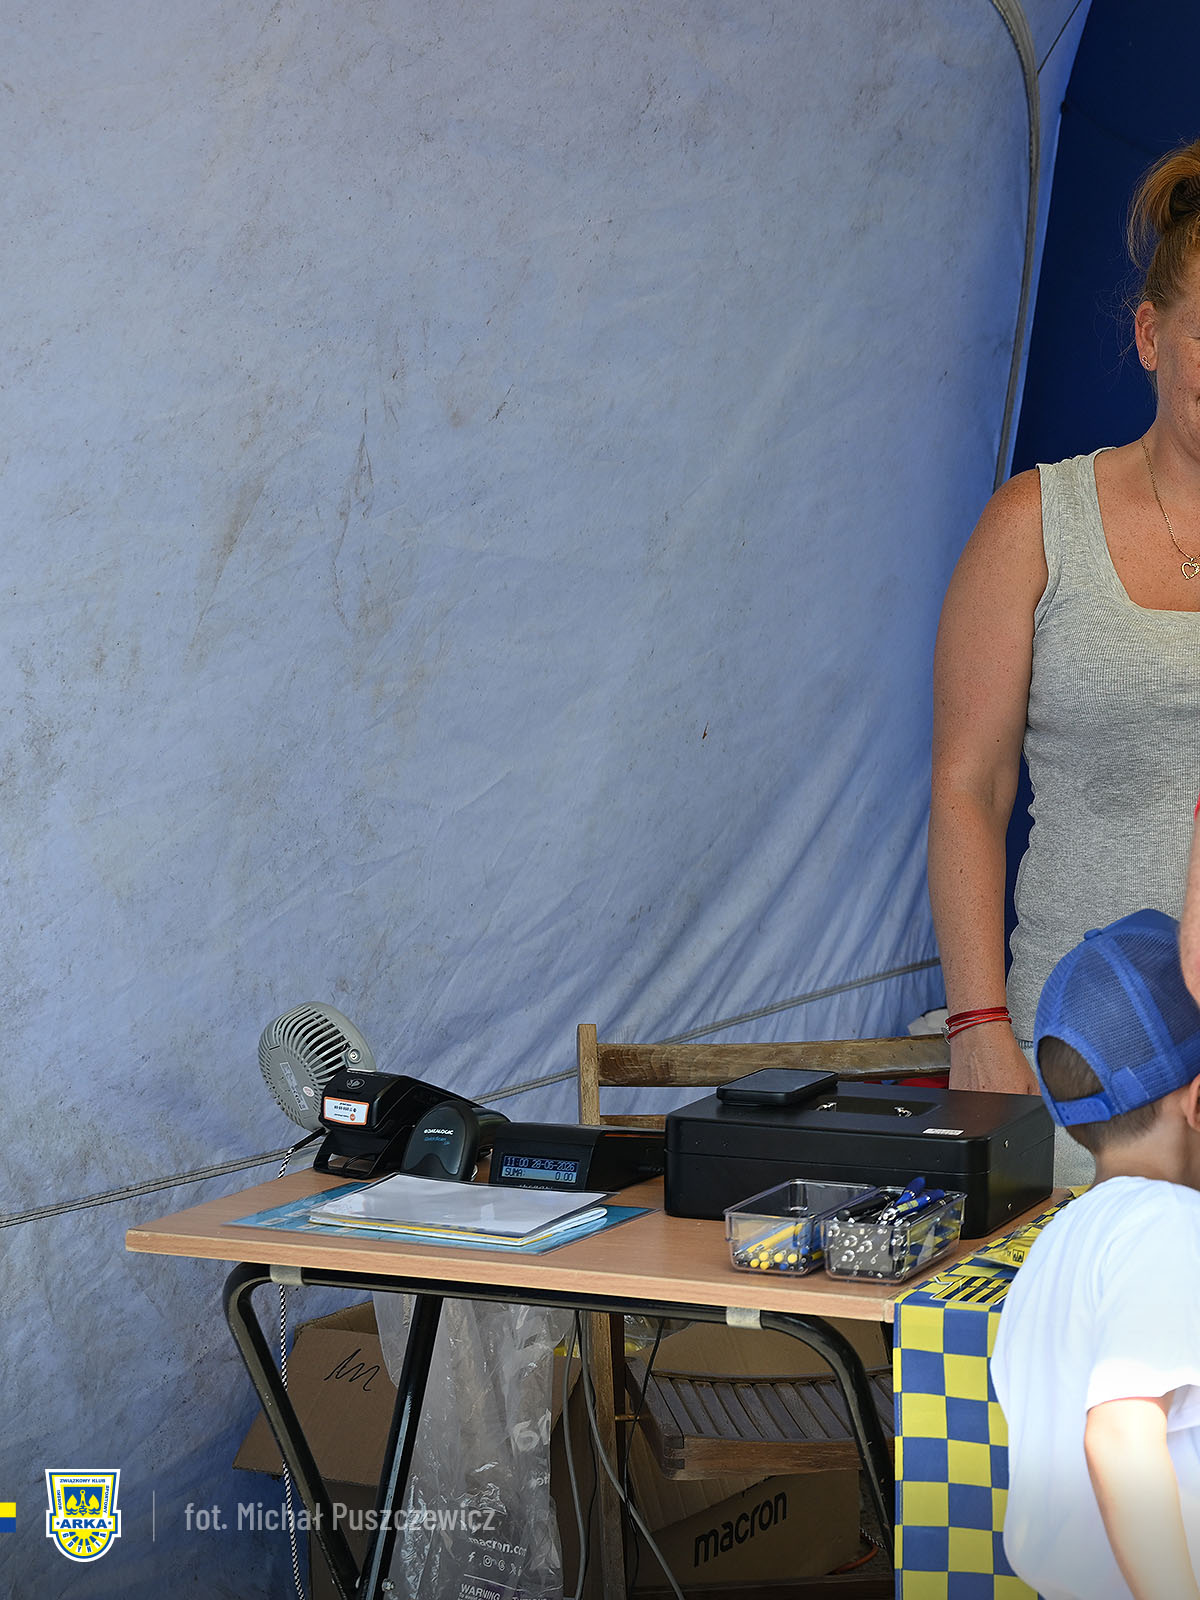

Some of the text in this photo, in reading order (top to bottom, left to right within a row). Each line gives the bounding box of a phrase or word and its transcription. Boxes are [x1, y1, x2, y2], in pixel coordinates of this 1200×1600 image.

[506, 1157, 575, 1172] 11:00 28-06-2026
[694, 1492, 787, 1568] macron
[461, 1583, 501, 1600] WARNING
